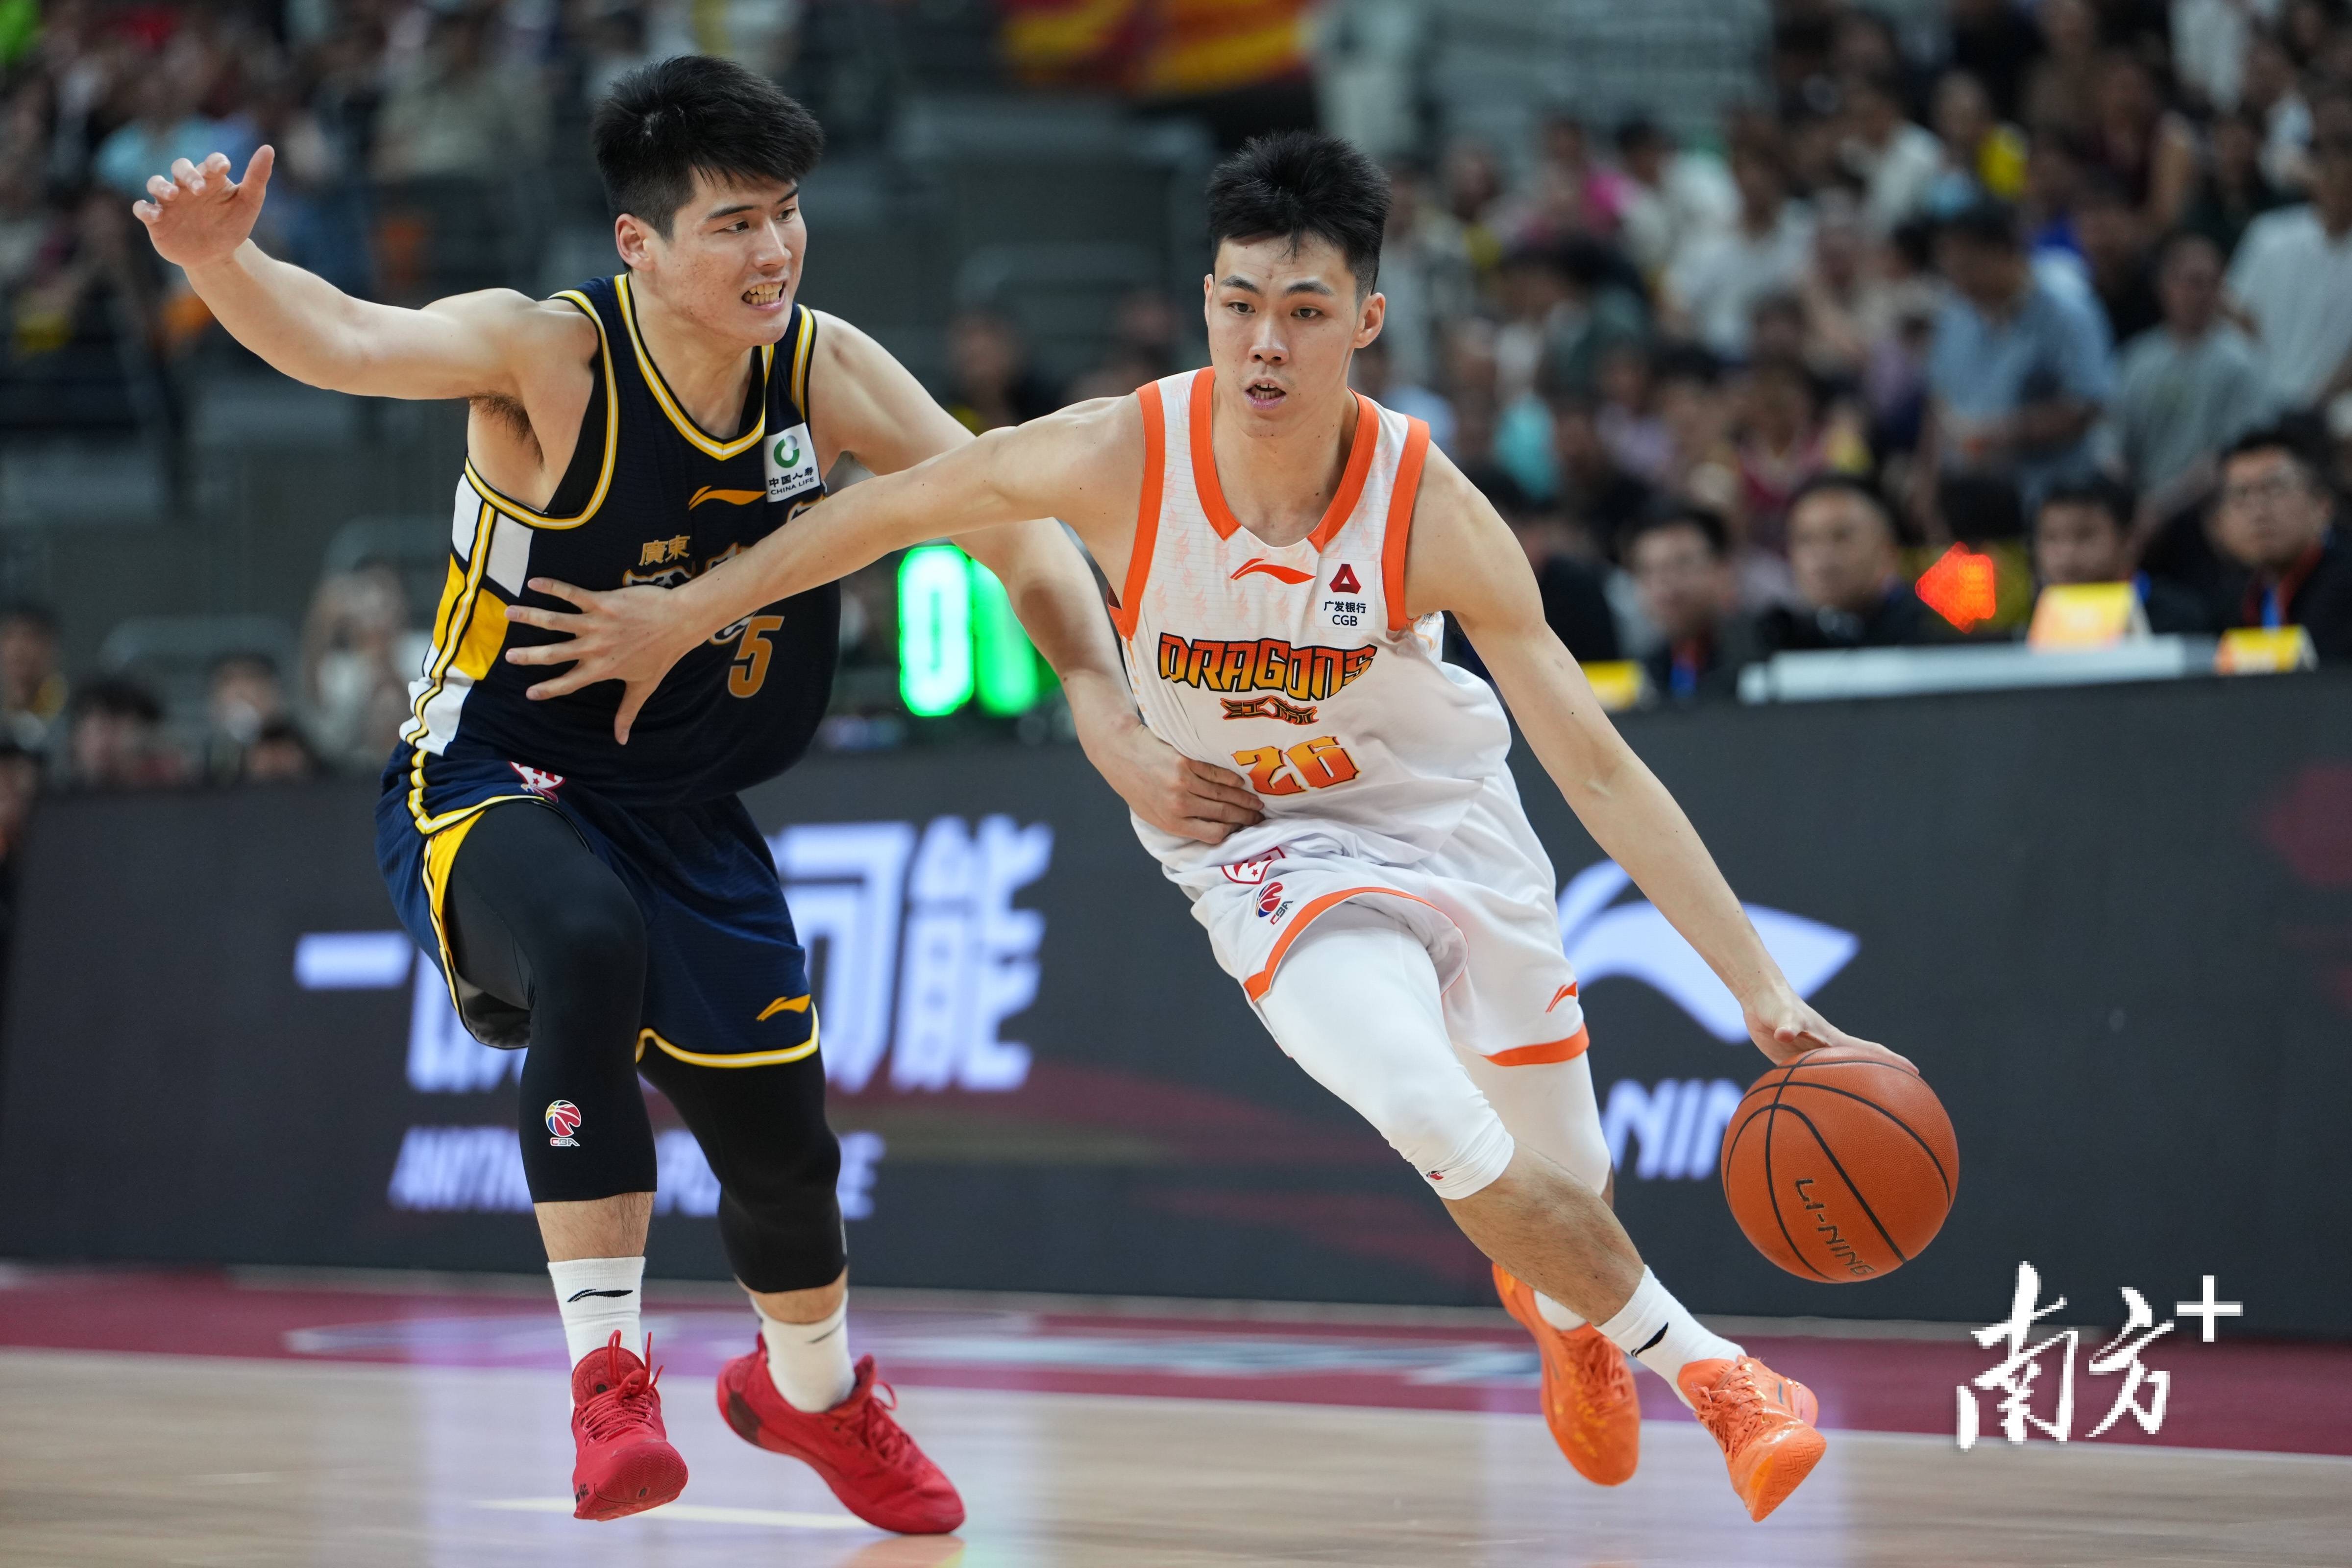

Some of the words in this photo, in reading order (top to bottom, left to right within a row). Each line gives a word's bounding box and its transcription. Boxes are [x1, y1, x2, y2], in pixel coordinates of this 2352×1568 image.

[768, 466, 814, 488] 中国人寿
[771, 484, 796, 495] CHINA
[799, 476, 814, 486] LIFE
[638, 535, 690, 566] 廣東
[1323, 601, 1366, 613] 广发银行
[1332, 614, 1358, 626] CGB
[727, 614, 785, 699] 5
[1157, 632, 1378, 702] DRAGONS
[1230, 735, 1361, 796] 26
[1270, 901, 1294, 925] CBA
[550, 1137, 581, 1147] CBA
[1795, 1178, 1876, 1275] LI-NING
